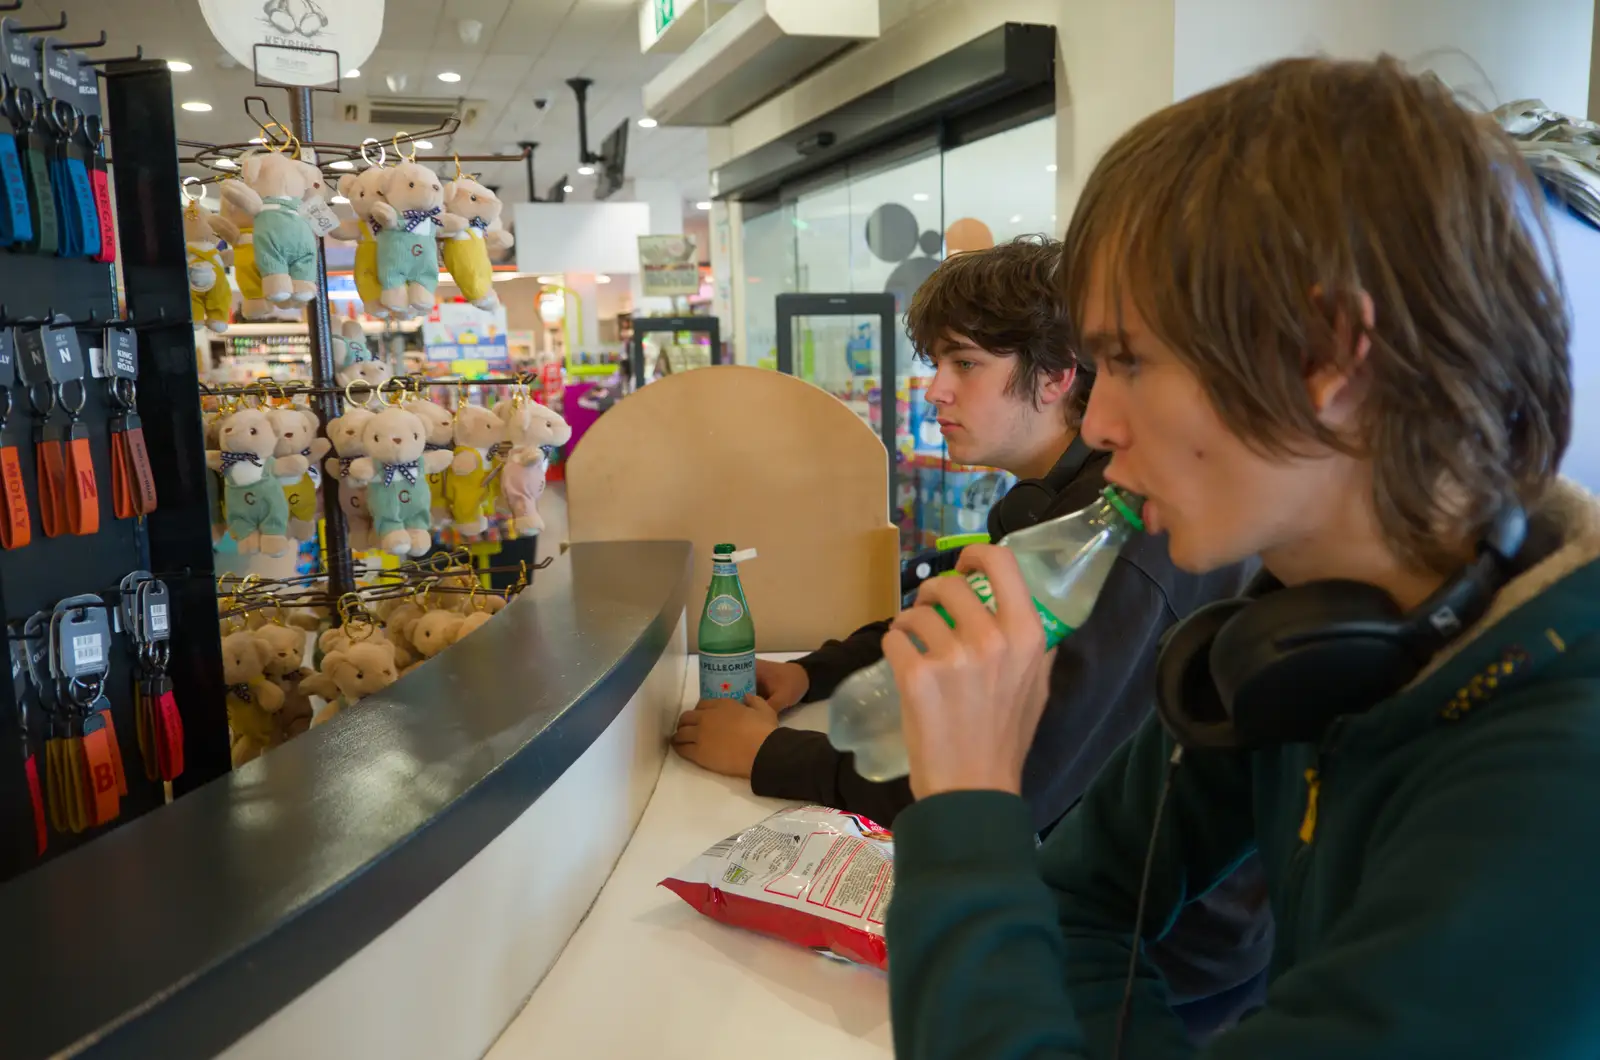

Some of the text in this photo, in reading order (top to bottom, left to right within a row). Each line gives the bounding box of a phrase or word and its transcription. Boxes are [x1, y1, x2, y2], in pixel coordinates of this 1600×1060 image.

[98, 183, 113, 247] MEGAN
[411, 243, 424, 257] G
[58, 347, 72, 364] N
[117, 349, 133, 360] KING
[117, 362, 135, 373] ROAD
[79, 469, 97, 500] N
[6, 461, 26, 528] MOLLY
[243, 491, 256, 506] C
[288, 493, 300, 505] C
[350, 495, 361, 508] C
[398, 489, 412, 503] C
[703, 660, 753, 672] PELLEGRINO
[93, 762, 113, 794] B
